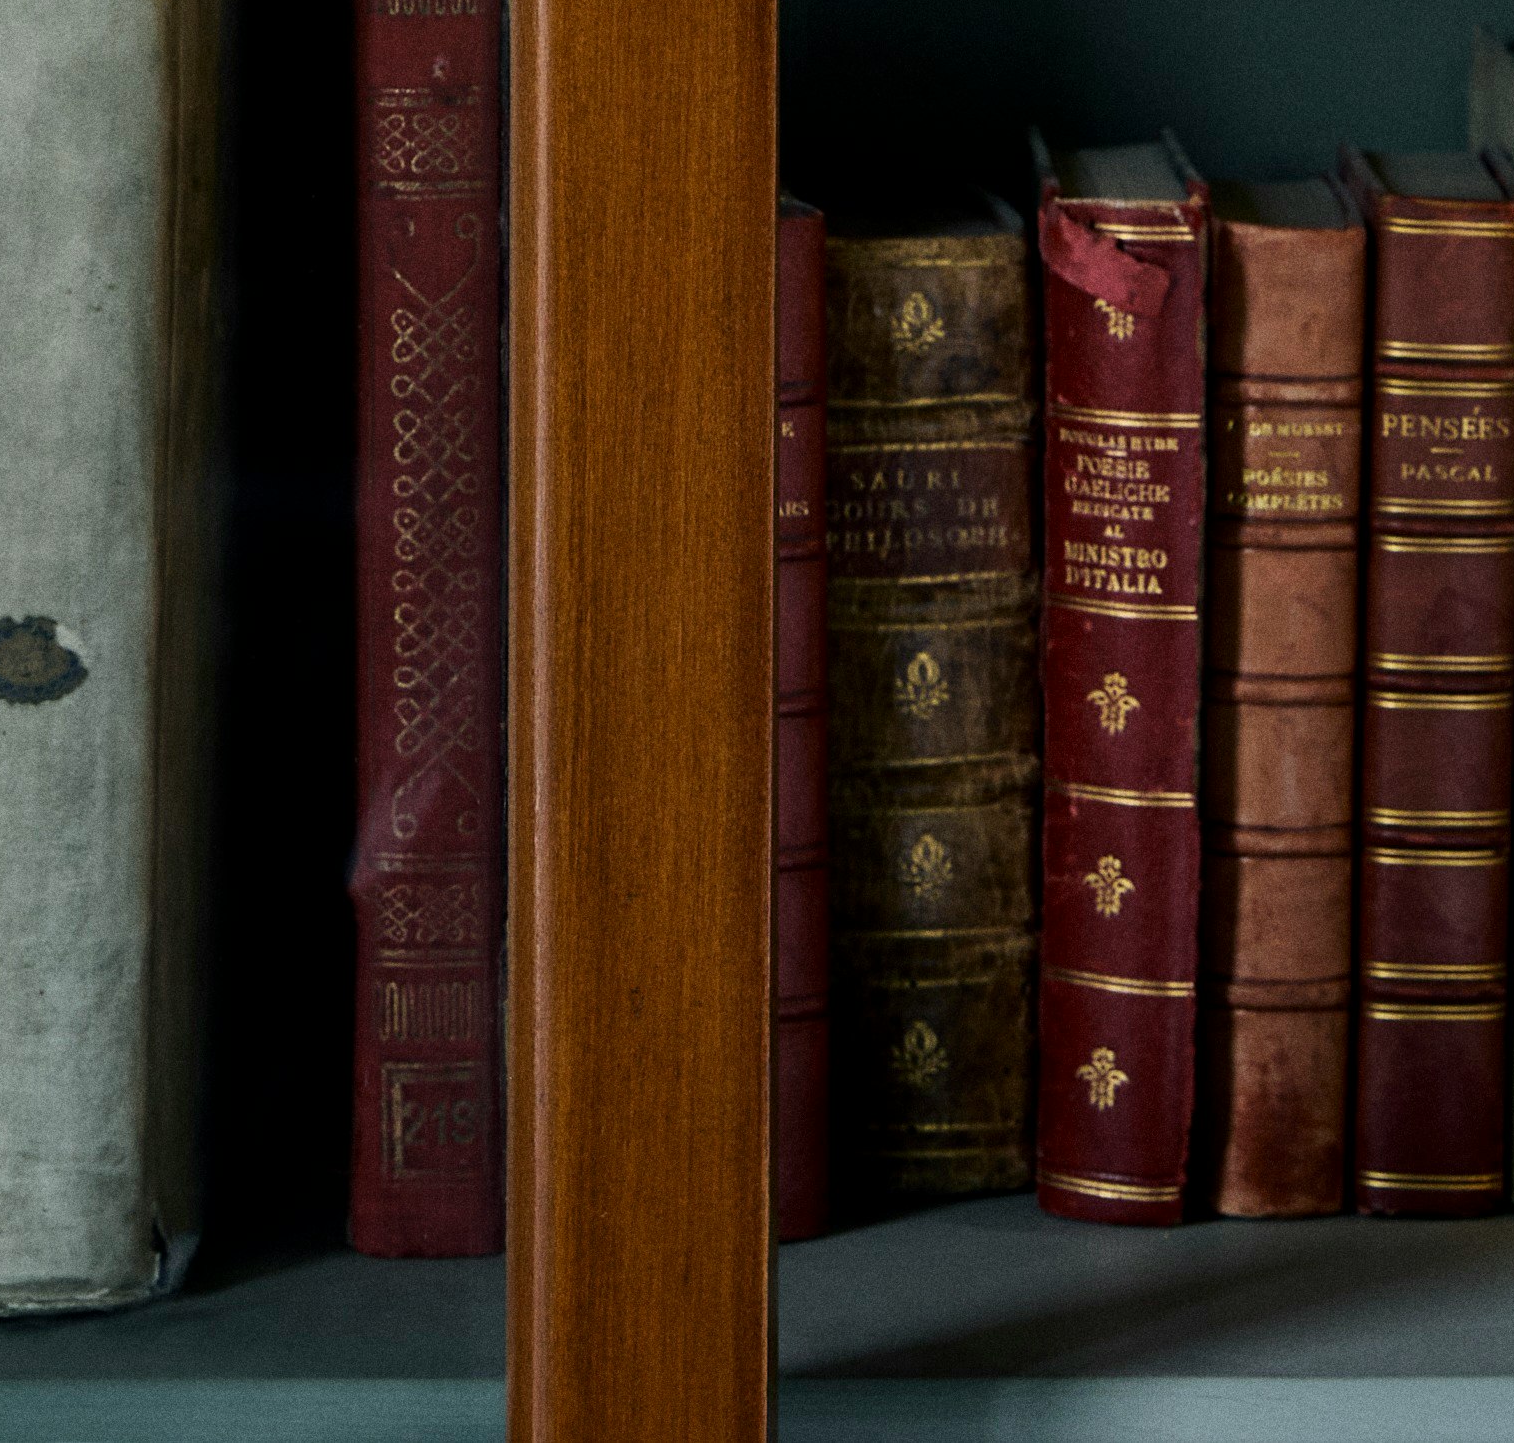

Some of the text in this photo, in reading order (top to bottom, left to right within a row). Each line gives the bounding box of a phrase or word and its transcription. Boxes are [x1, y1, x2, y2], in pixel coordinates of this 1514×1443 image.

[1381, 404, 1510, 441] PENSÉES
[1400, 462, 1498, 483] PASCAL
[1064, 474, 1171, 503] GAELICHE
[1103, 524, 1125, 539] AL
[1064, 539, 1169, 569] MINISTRO
